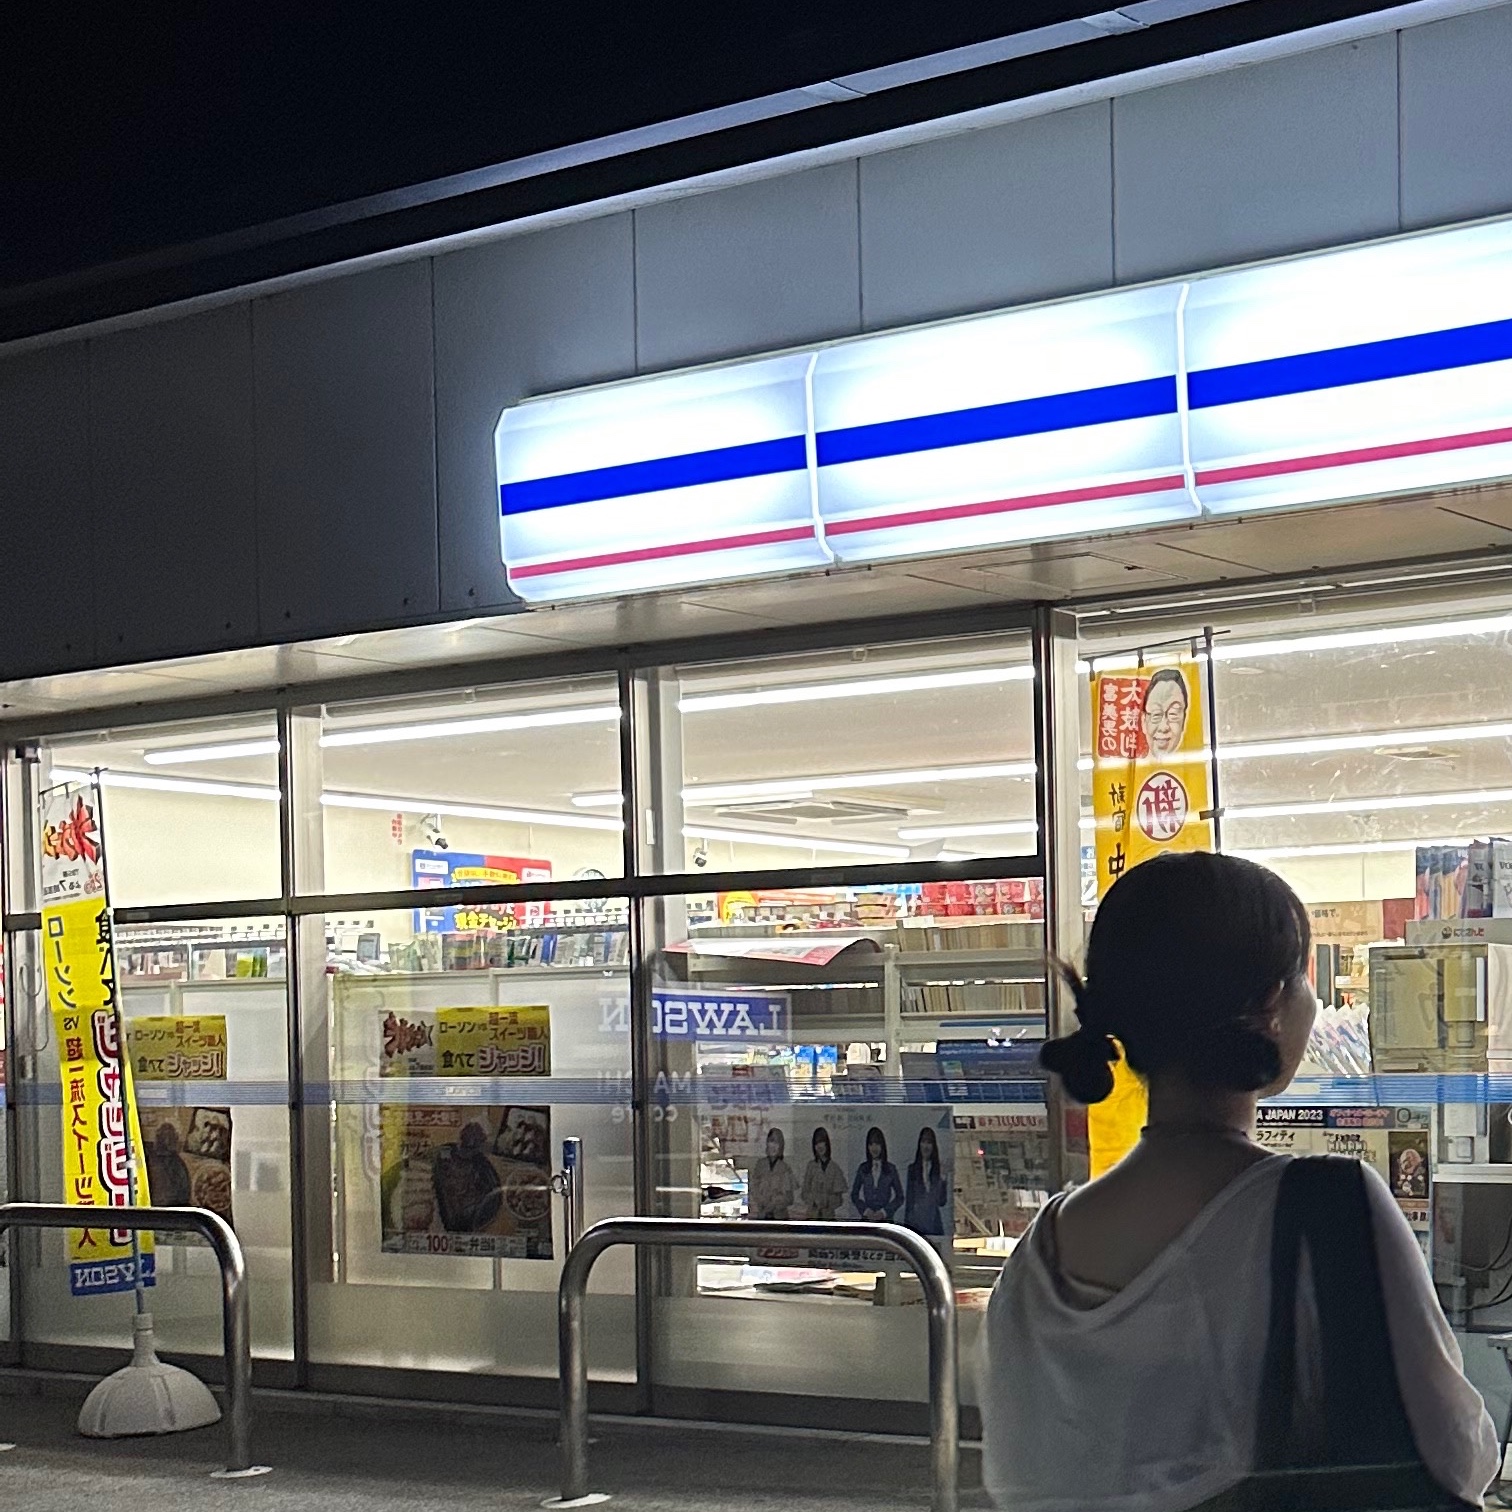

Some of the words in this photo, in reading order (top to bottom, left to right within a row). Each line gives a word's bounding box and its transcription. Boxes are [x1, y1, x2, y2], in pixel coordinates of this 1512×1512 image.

[439, 1021, 478, 1034] ローソン
[138, 1055, 165, 1073] 食べて
[166, 1050, 224, 1079] ジャッジ!
[441, 1049, 476, 1069] 食べて
[477, 1044, 547, 1074] ジャッジ!
[1265, 1109, 1295, 1121] JAPAN
[1297, 1109, 1324, 1121] 2023
